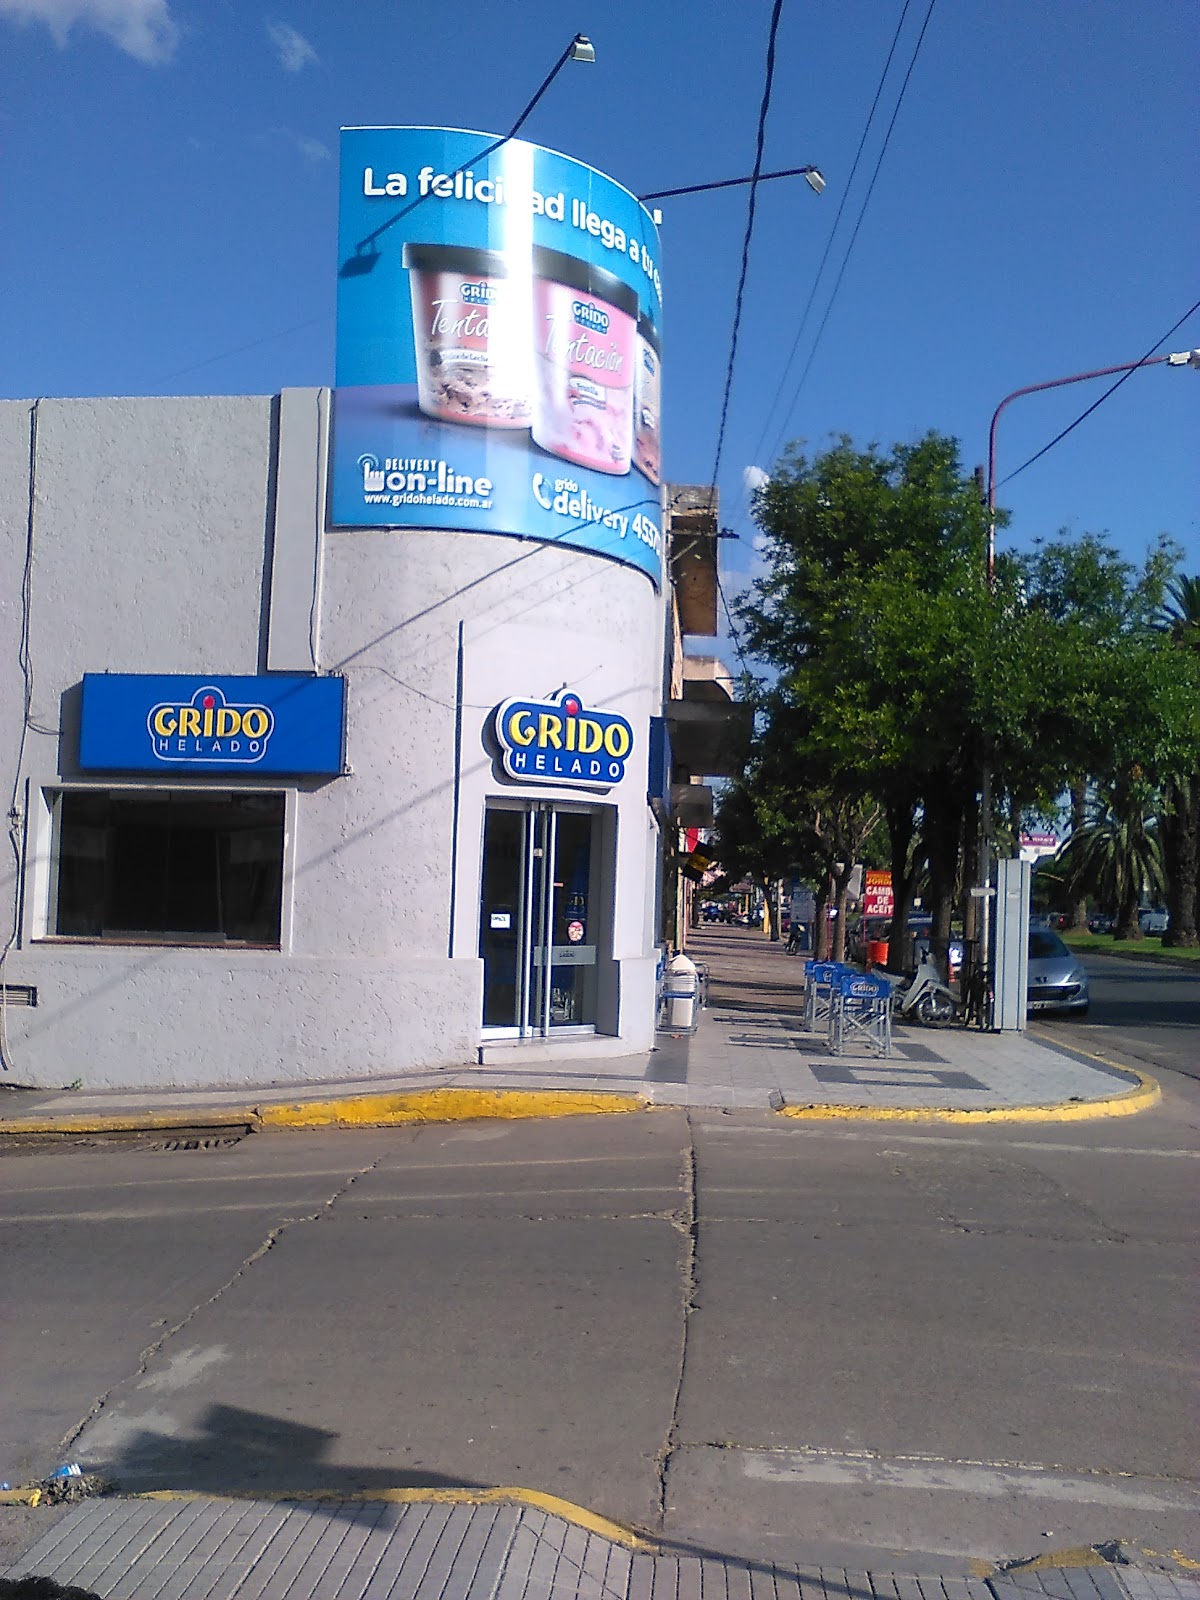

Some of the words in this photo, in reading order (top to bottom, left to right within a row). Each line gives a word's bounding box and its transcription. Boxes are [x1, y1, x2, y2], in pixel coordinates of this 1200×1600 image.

[364, 167, 407, 196] La
[418, 166, 564, 222] feliciad
[572, 198, 626, 252] llega
[629, 239, 639, 263] a
[641, 245, 653, 279] tu
[573, 302, 609, 328] GRIDO
[385, 458, 436, 472] DELIVERY
[386, 460, 492, 496] on-line
[554, 479, 578, 492] grido
[364, 492, 492, 509] www.gridohelado.com.ar
[553, 489, 629, 539] delivery
[154, 697, 268, 738] GRIDO
[509, 699, 630, 757] GRIDO
[159, 739, 260, 753] HELADO
[515, 752, 620, 778] HELADO
[877, 896, 889, 904] DE
